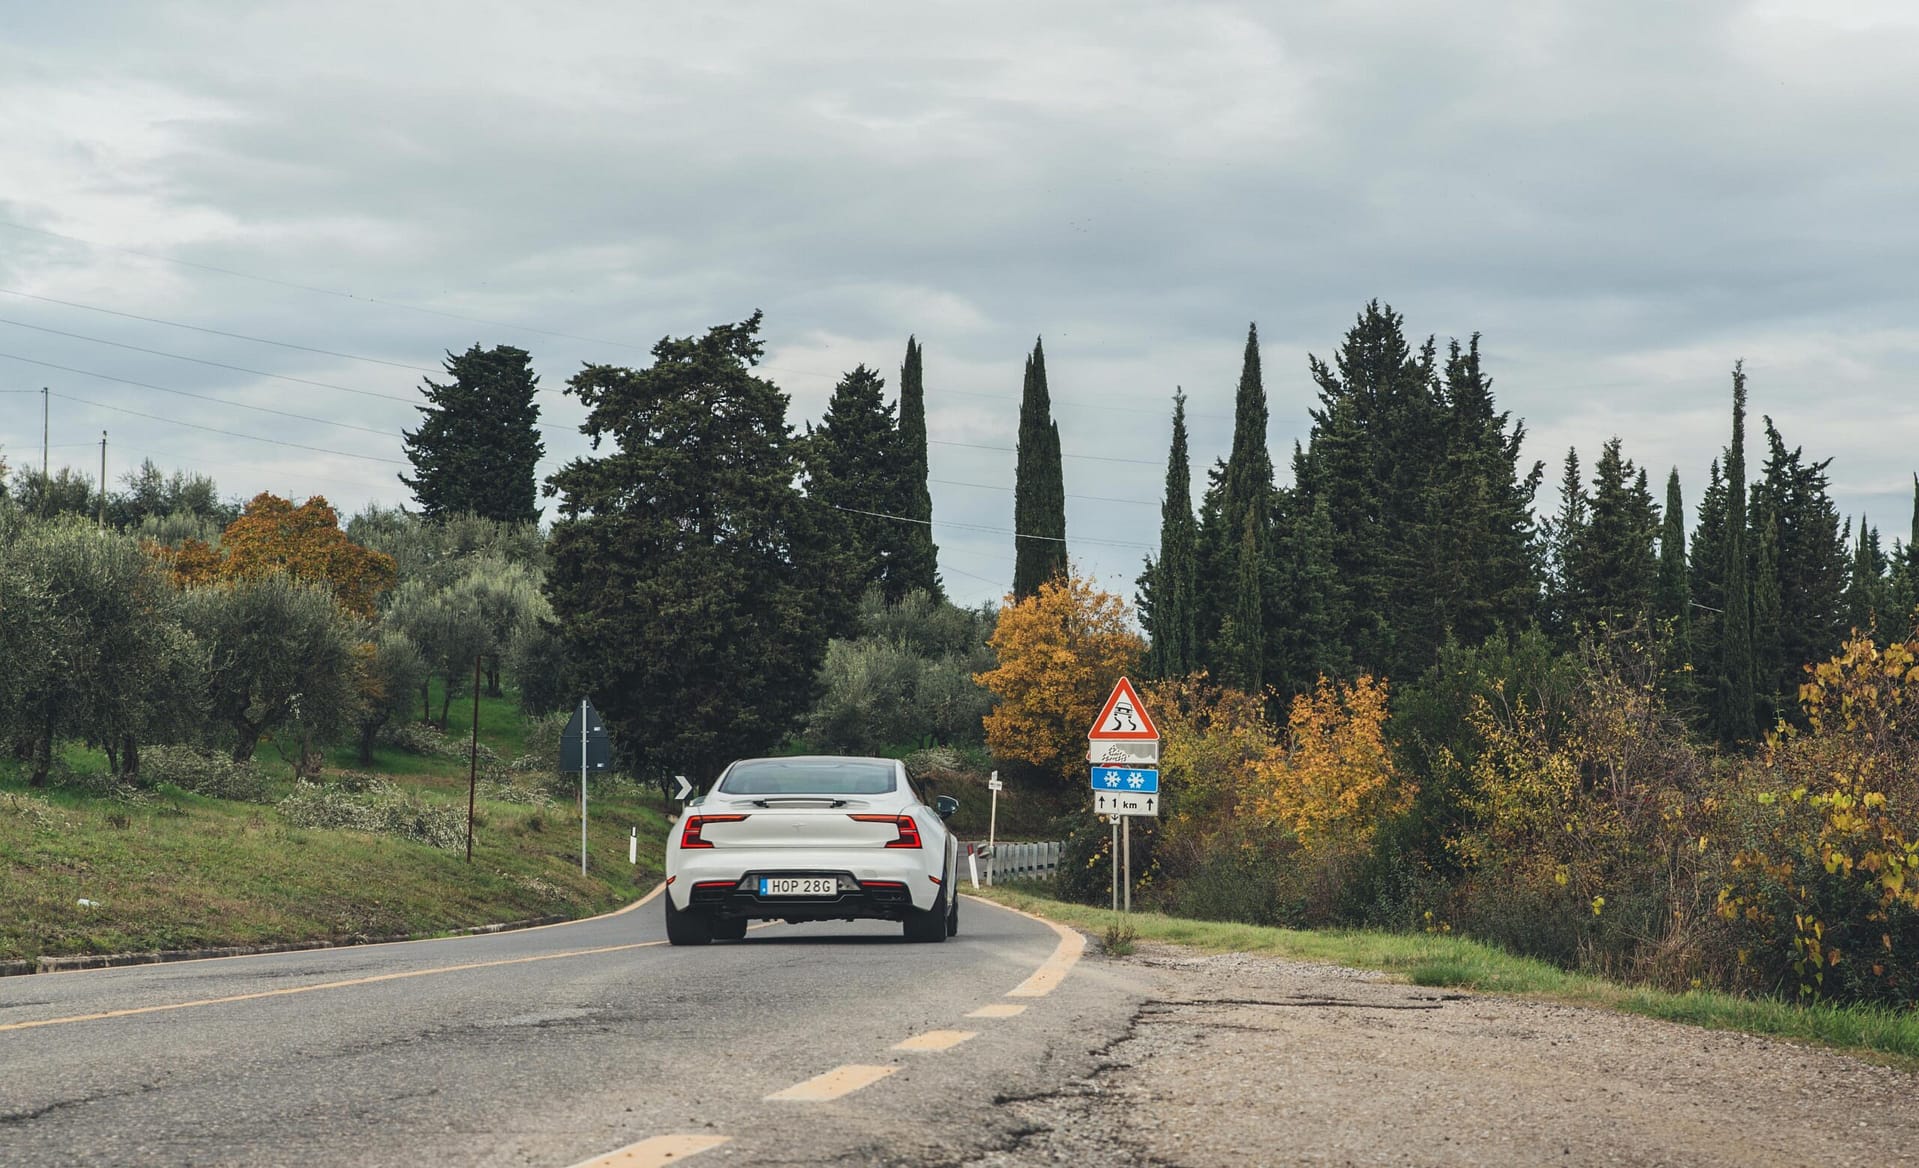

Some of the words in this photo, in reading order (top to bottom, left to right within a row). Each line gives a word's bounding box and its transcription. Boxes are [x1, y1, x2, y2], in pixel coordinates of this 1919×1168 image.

[1112, 798, 1117, 808] 1
[1123, 801, 1137, 809] km
[772, 880, 799, 893] HOP
[803, 880, 831, 893] 28G
